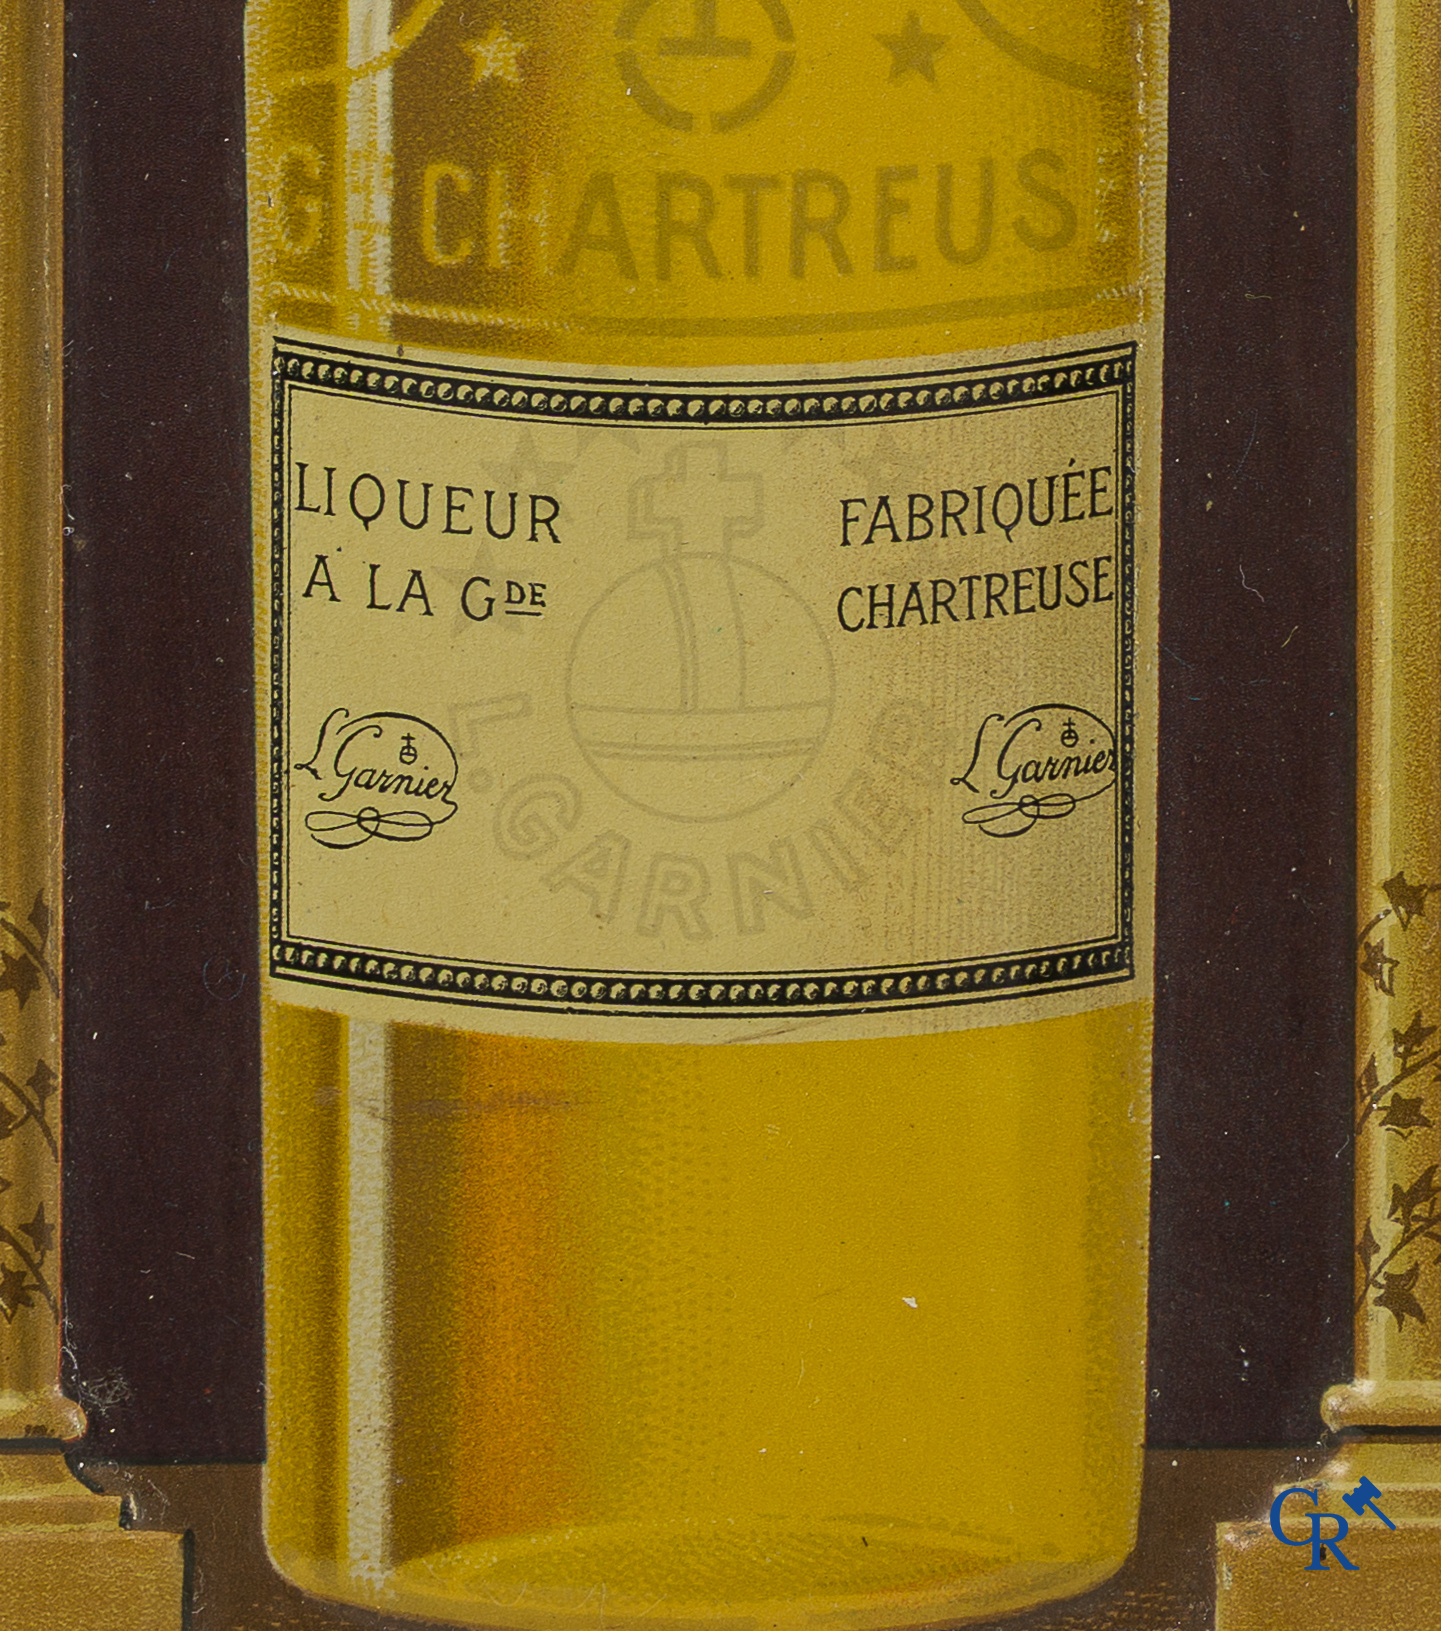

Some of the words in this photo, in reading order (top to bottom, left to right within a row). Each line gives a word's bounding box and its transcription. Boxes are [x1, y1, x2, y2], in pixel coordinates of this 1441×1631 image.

[294, 461, 562, 544] LIQUEUR
[839, 458, 1113, 547] FABRIQUÉE
[365, 562, 435, 617] LA
[837, 554, 1114, 632] CHARTREUSE
